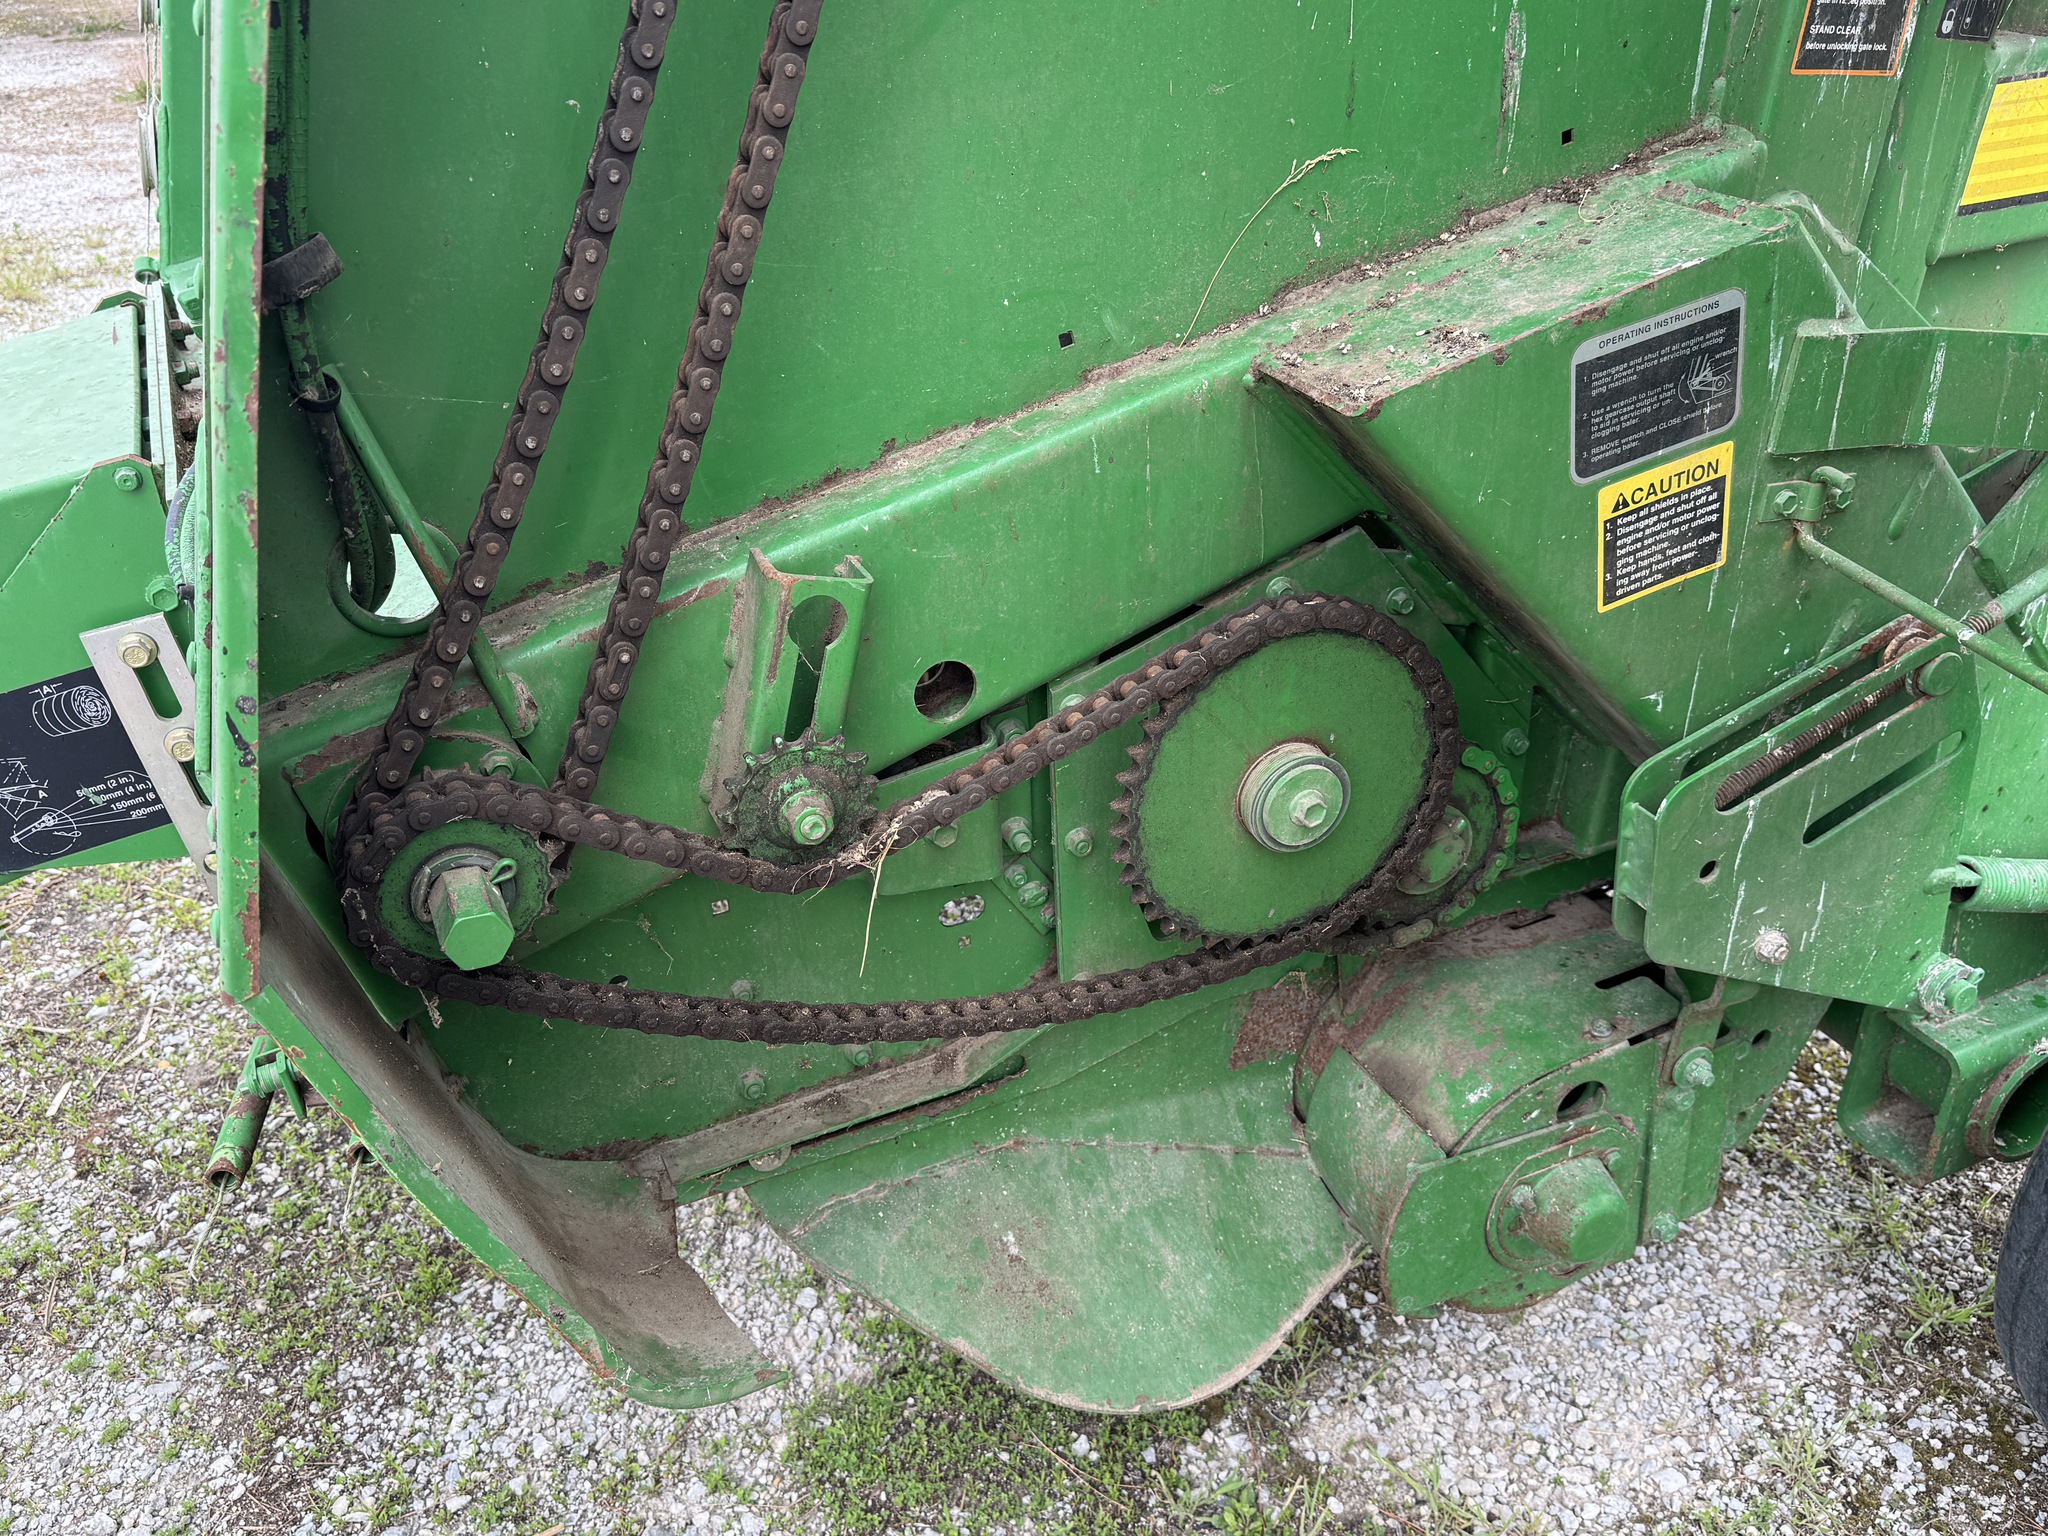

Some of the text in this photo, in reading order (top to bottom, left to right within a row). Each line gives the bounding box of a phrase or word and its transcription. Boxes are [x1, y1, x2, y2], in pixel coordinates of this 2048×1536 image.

[1810, 25, 1862, 35] STAND CLEAR
[1806, 42, 1887, 52] before unlocking gate lock.
[1599, 300, 1720, 349] OPERATING INSTRUCTIONS
[1591, 362, 1628, 380] Disengage
[1629, 356, 1642, 366] and
[1644, 350, 1659, 360] shut
[1661, 346, 1671, 355] off
[1672, 343, 1680, 351] all
[1681, 335, 1704, 348] engine
[1705, 327, 1727, 340] and/or
[1715, 346, 1738, 359] wrench
[1591, 376, 1612, 388] motor
[1613, 367, 1635, 380] power
[1636, 359, 1658, 372] before
[1659, 348, 1691, 363] servicing
[1692, 344, 1699, 352] or
[1591, 374, 1639, 397] ging machine.
[1591, 407, 1605, 417] Use
[1612, 395, 1637, 409] wrench
[1647, 387, 1662, 396] turn
[1663, 382, 1674, 391] the
[1591, 388, 1676, 425] hex gearcase output shaft
[1591, 417, 1640, 440] clogging baler.
[1600, 420, 1610, 429] aid
[1620, 405, 1651, 421] servicing
[1652, 402, 1660, 410] or
[1591, 439, 1620, 455] REMOVE
[1621, 431, 1645, 444] wrench
[1645, 425, 1658, 435] and
[1658, 416, 1682, 430] CLOSE
[1682, 408, 1702, 421] shield
[1591, 440, 1640, 463] operating baler.
[1630, 458, 1720, 505] CAUTION
[1605, 491, 1718, 541] 2. Disengage and shut off all
[1606, 485, 1713, 530] 1. Keep all shields in place.
[1616, 502, 1721, 547] engine and/or motor power
[1616, 513, 1720, 557] before servicing or unclog-
[1605, 573, 1613, 581] 3.
[1616, 564, 1637, 577] Keep
[1665, 545, 1681, 557] feet
[1682, 539, 1697, 551] and
[1697, 531, 1721, 545] cloth-
[1616, 541, 1671, 568] ging machine.
[1616, 576, 1629, 587] ing
[1630, 568, 1650, 581] away
[1652, 561, 1670, 572] from
[1616, 573, 1664, 596] driven parts.
[43, 685, 53, 694] A
[38, 789, 48, 799] A
[89, 780, 152, 805] 10mm (4 in.)
[107, 779, 118, 789] (2
[117, 773, 135, 785] in.)
[110, 791, 156, 811] 150mm (6
[130, 803, 165, 818] 200mm
